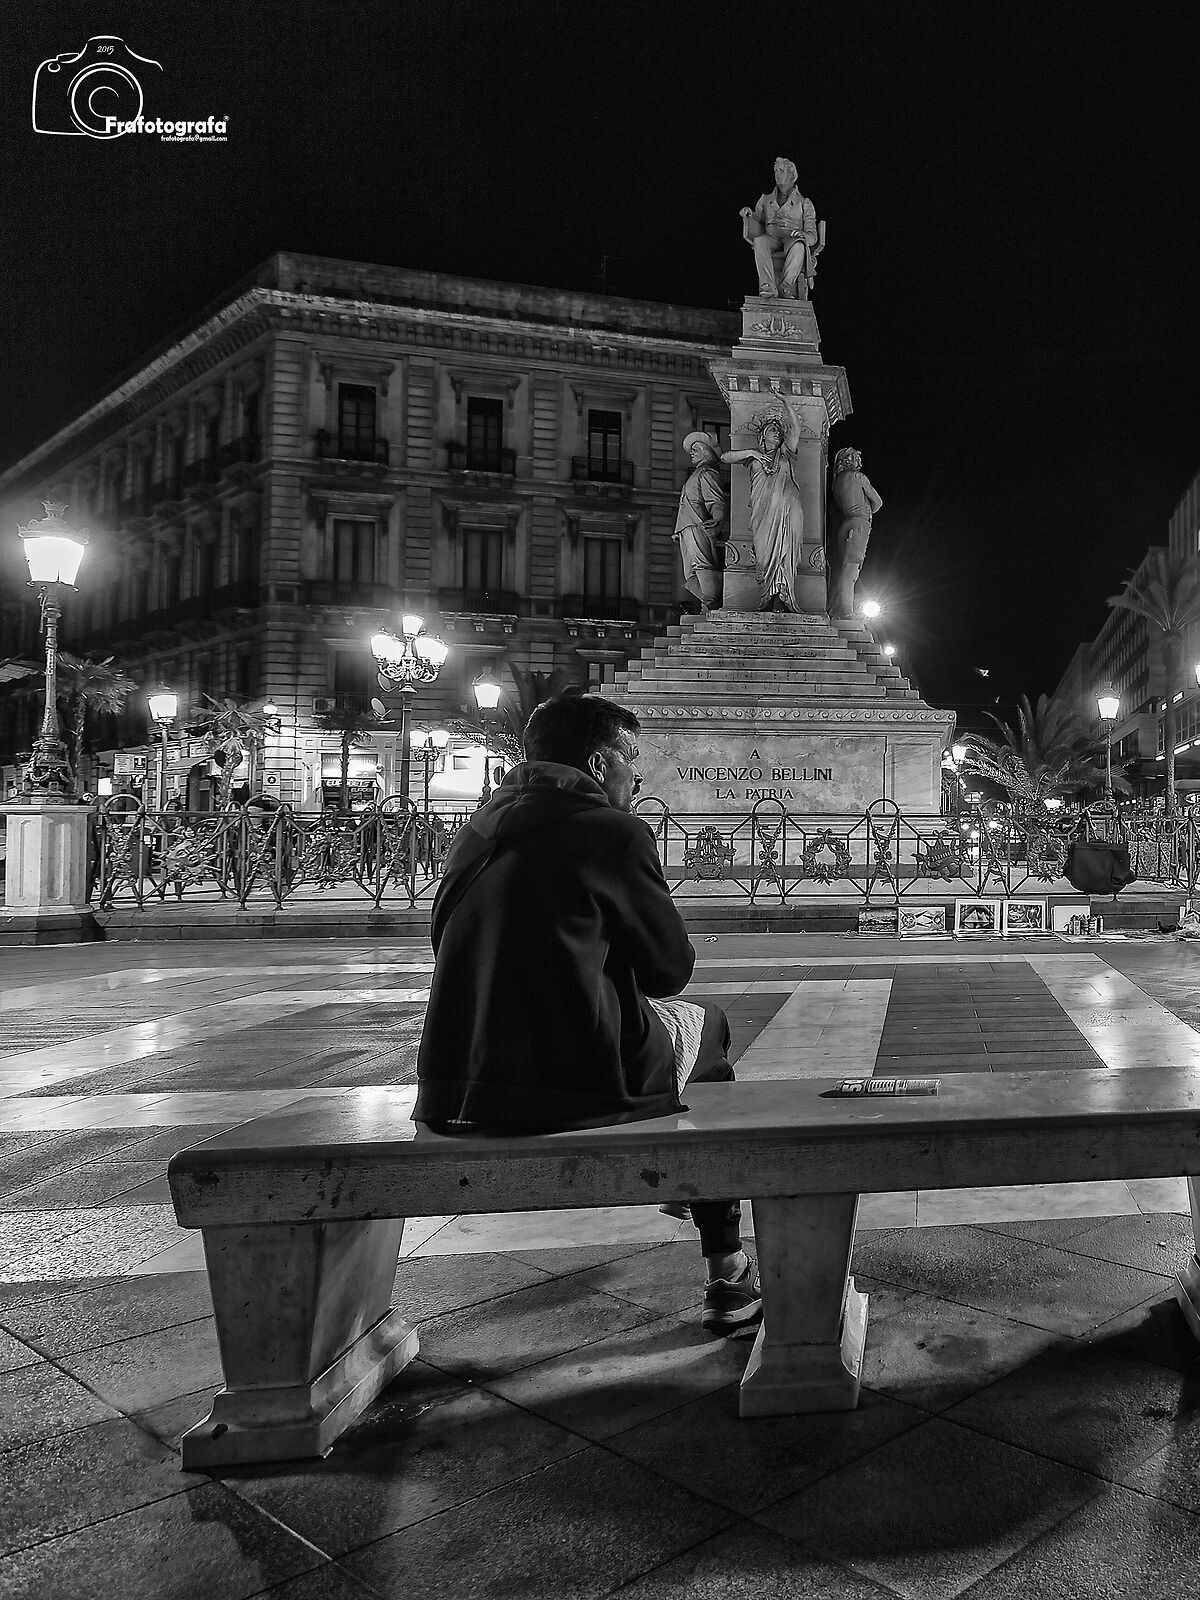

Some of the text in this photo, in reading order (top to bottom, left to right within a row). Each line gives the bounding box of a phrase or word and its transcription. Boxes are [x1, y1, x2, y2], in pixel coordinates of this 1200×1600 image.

[750, 749, 760, 760] A
[677, 767, 832, 782] VINCENZO BELLINI
[716, 789, 793, 800] LA PATRIA
